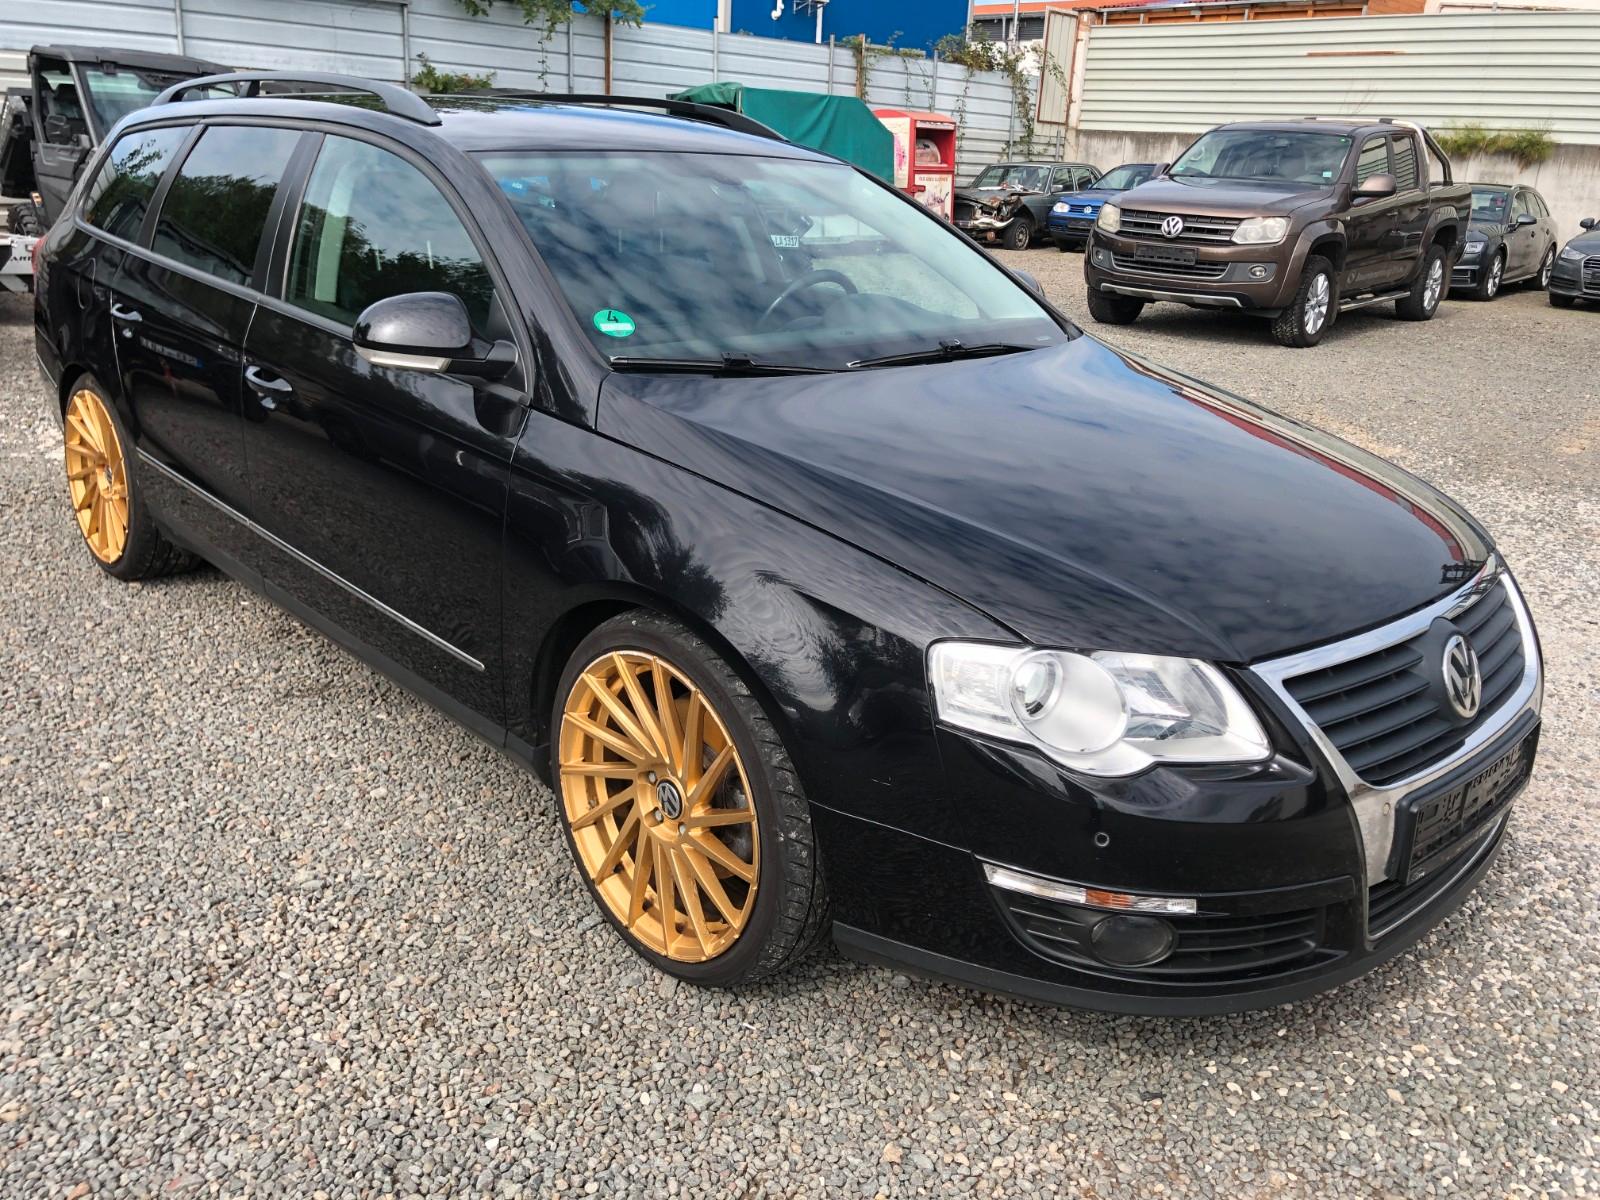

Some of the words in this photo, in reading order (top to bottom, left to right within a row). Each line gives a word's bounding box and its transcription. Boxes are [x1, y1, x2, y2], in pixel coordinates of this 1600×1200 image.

[1161, 216, 1184, 238] VW
[607, 310, 619, 323] 4
[1442, 635, 1482, 718] VW
